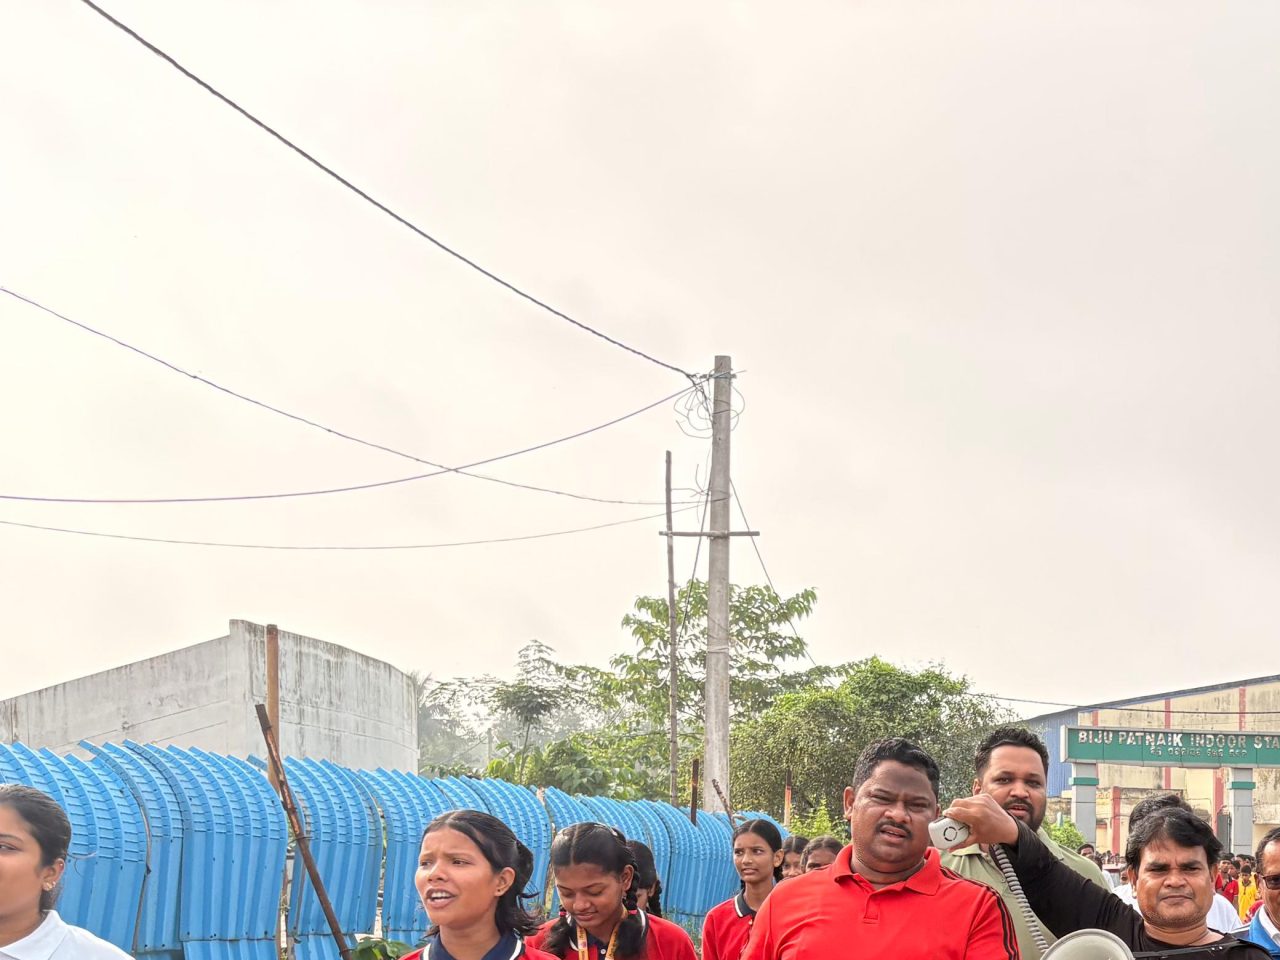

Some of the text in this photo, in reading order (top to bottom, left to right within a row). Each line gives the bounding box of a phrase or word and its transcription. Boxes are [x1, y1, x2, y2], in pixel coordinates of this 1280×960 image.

[1078, 731, 1113, 745] BIJU
[1118, 732, 1183, 747] PATNAIK
[1190, 734, 1246, 748] INDOOR
